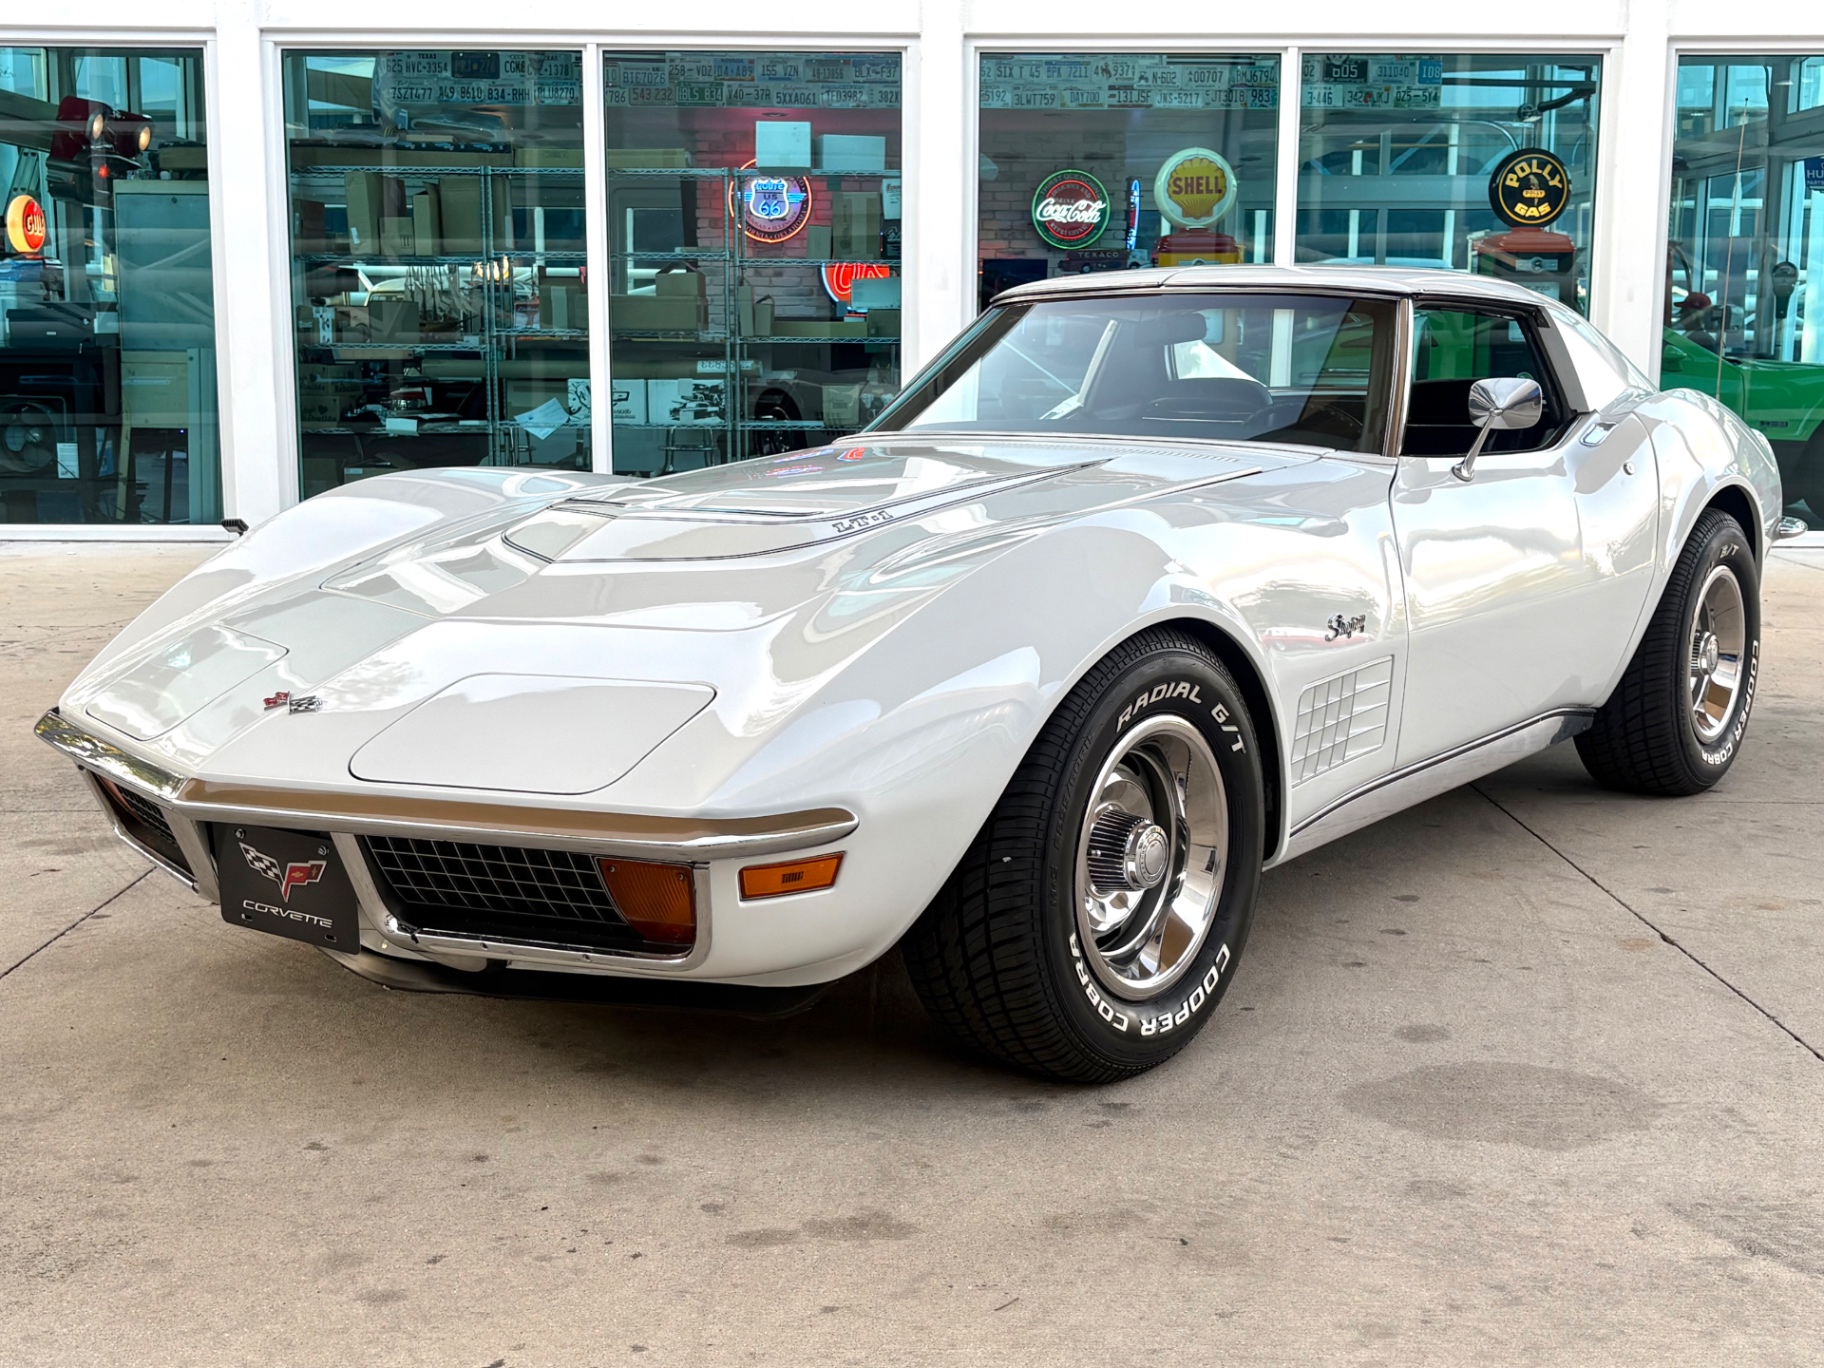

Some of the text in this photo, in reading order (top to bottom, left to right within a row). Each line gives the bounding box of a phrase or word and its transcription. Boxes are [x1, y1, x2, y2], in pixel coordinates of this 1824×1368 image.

[761, 65, 777, 77] 155
[1029, 65, 1040, 78] 45
[632, 87, 651, 101] 543
[1505, 160, 1562, 189] POLLY
[756, 181, 784, 191] ROUTE
[1172, 176, 1223, 195] SHELL
[759, 200, 781, 216] 66
[1514, 203, 1551, 217] GAS
[1702, 640, 1759, 764] COOPER COBRA
[1116, 681, 1247, 754] RADIAL G/T
[243, 899, 333, 928] CORVETTE
[1069, 931, 1232, 1036] COOPER COBRA
